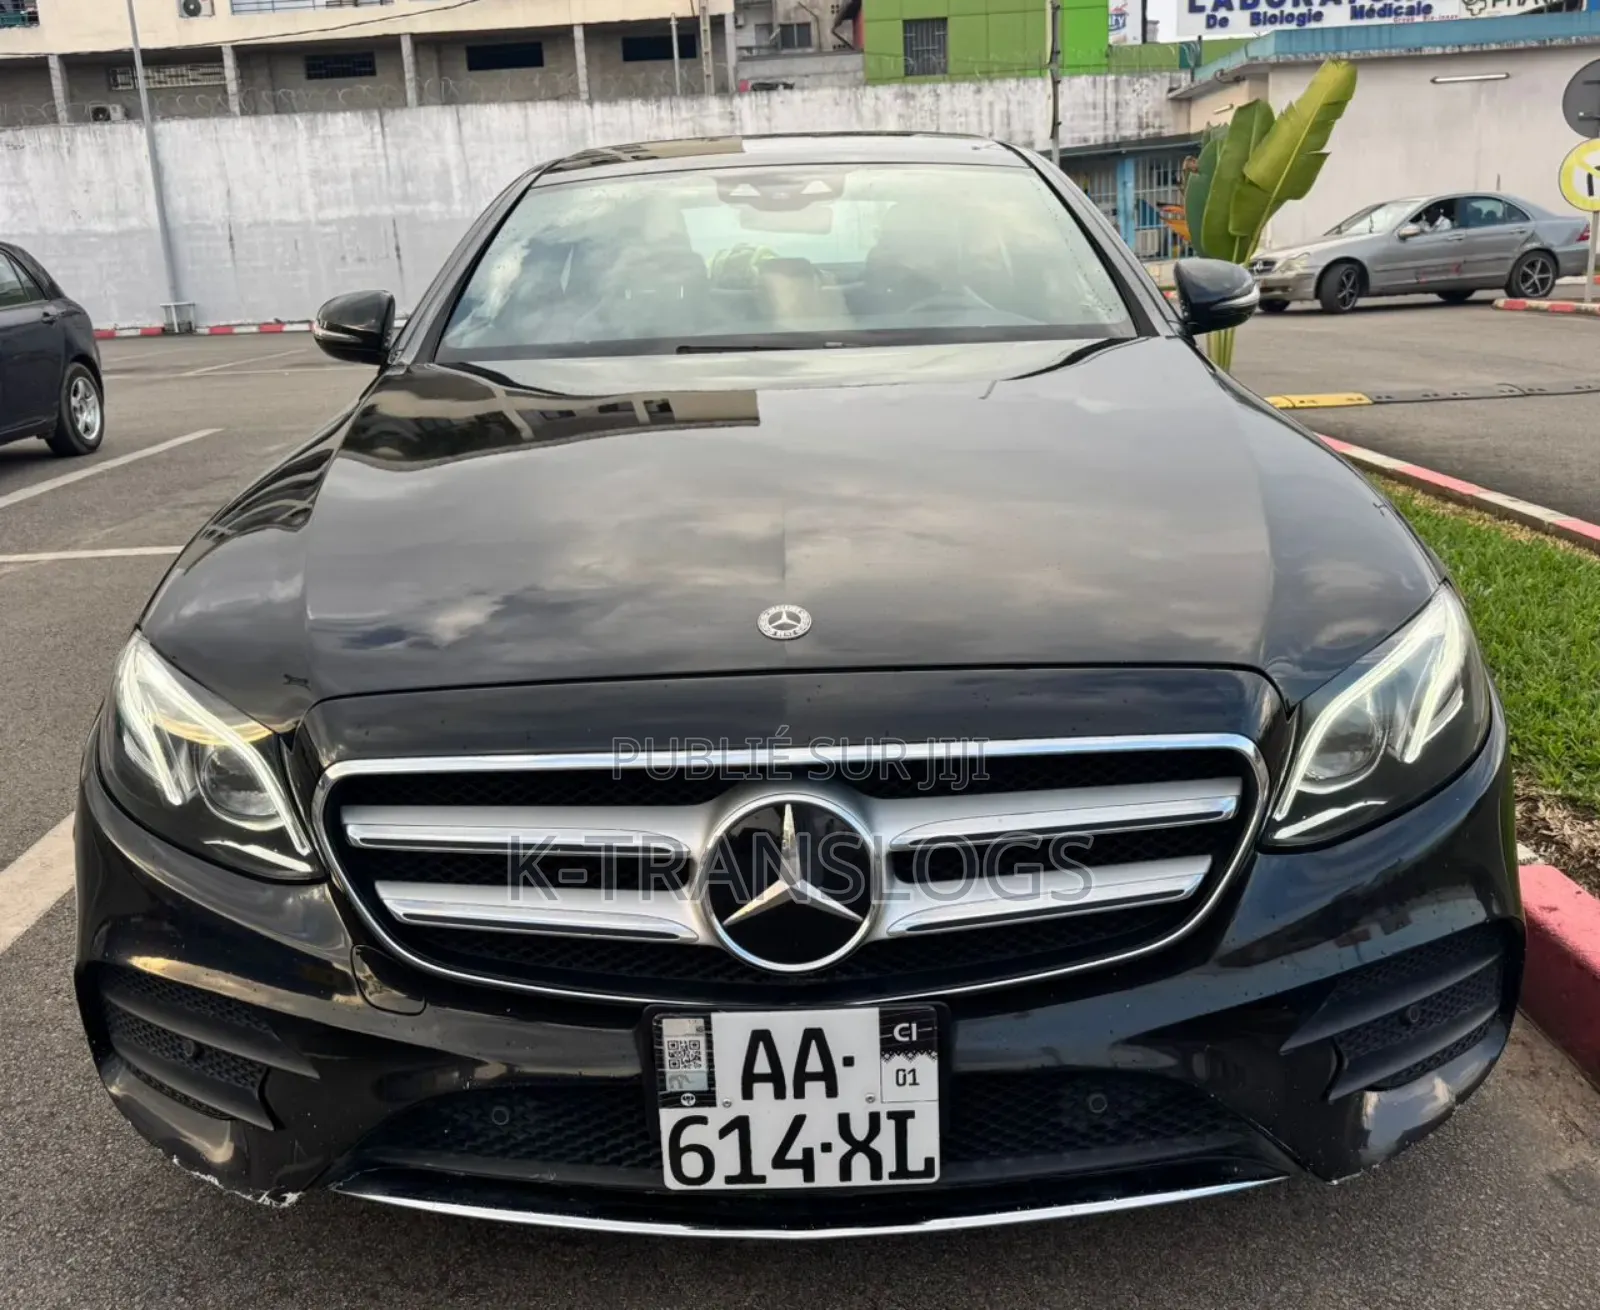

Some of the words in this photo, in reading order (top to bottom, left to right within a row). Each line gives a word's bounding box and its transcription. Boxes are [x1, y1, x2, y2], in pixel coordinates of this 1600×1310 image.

[1205, 14, 1229, 29] De
[1250, 8, 1324, 27] Biologie
[1350, 1, 1433, 20] Médicale
[893, 1023, 917, 1041] CI
[895, 1068, 920, 1087] 01
